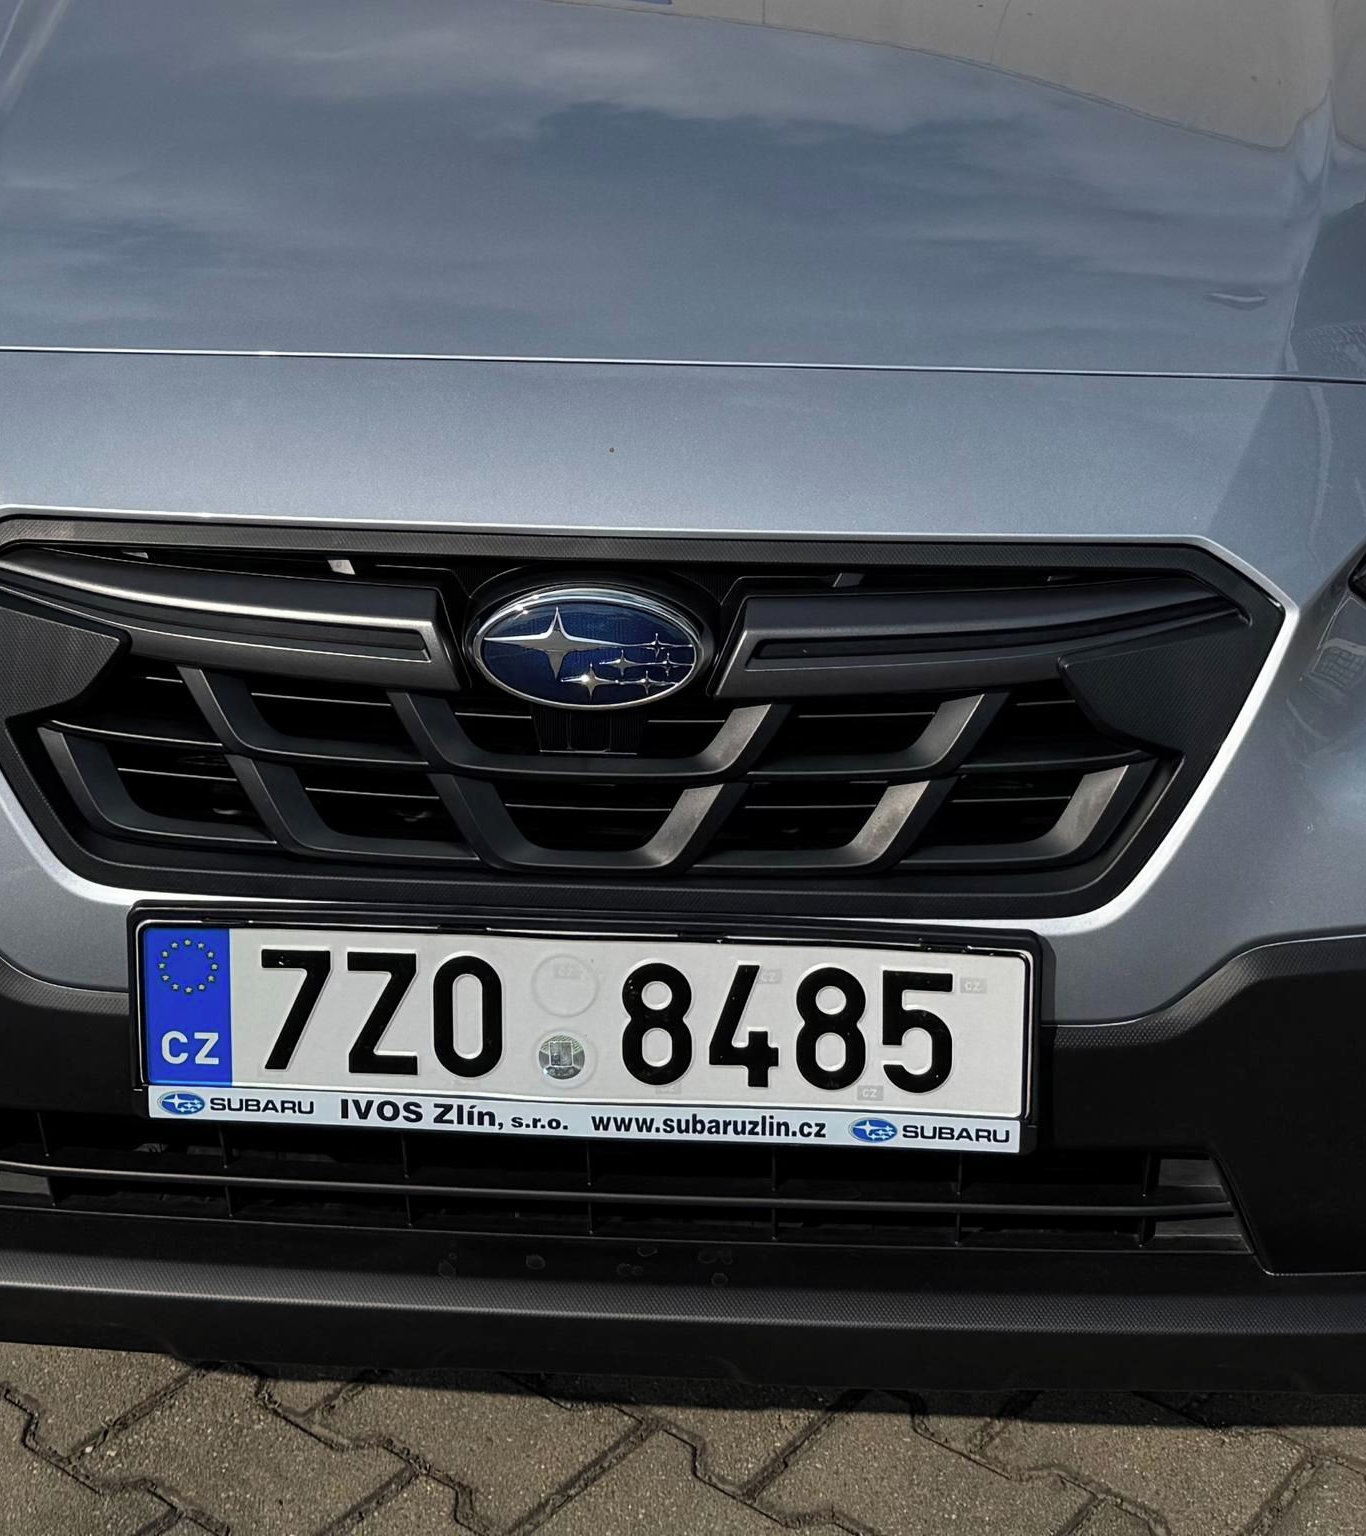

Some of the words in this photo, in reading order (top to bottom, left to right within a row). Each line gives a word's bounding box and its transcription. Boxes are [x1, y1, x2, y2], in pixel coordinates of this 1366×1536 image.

[161, 1030, 220, 1066] CZ
[260, 948, 503, 1078] 7Z0
[621, 961, 954, 1094] 8485
[210, 1097, 315, 1115] SUBARU
[340, 1098, 424, 1124] IVOS
[432, 1101, 505, 1131] Zlín,
[510, 1114, 569, 1131] s.r.o.
[591, 1112, 827, 1139] www.subaruzlin.cz
[902, 1124, 1011, 1144] SUBARU
